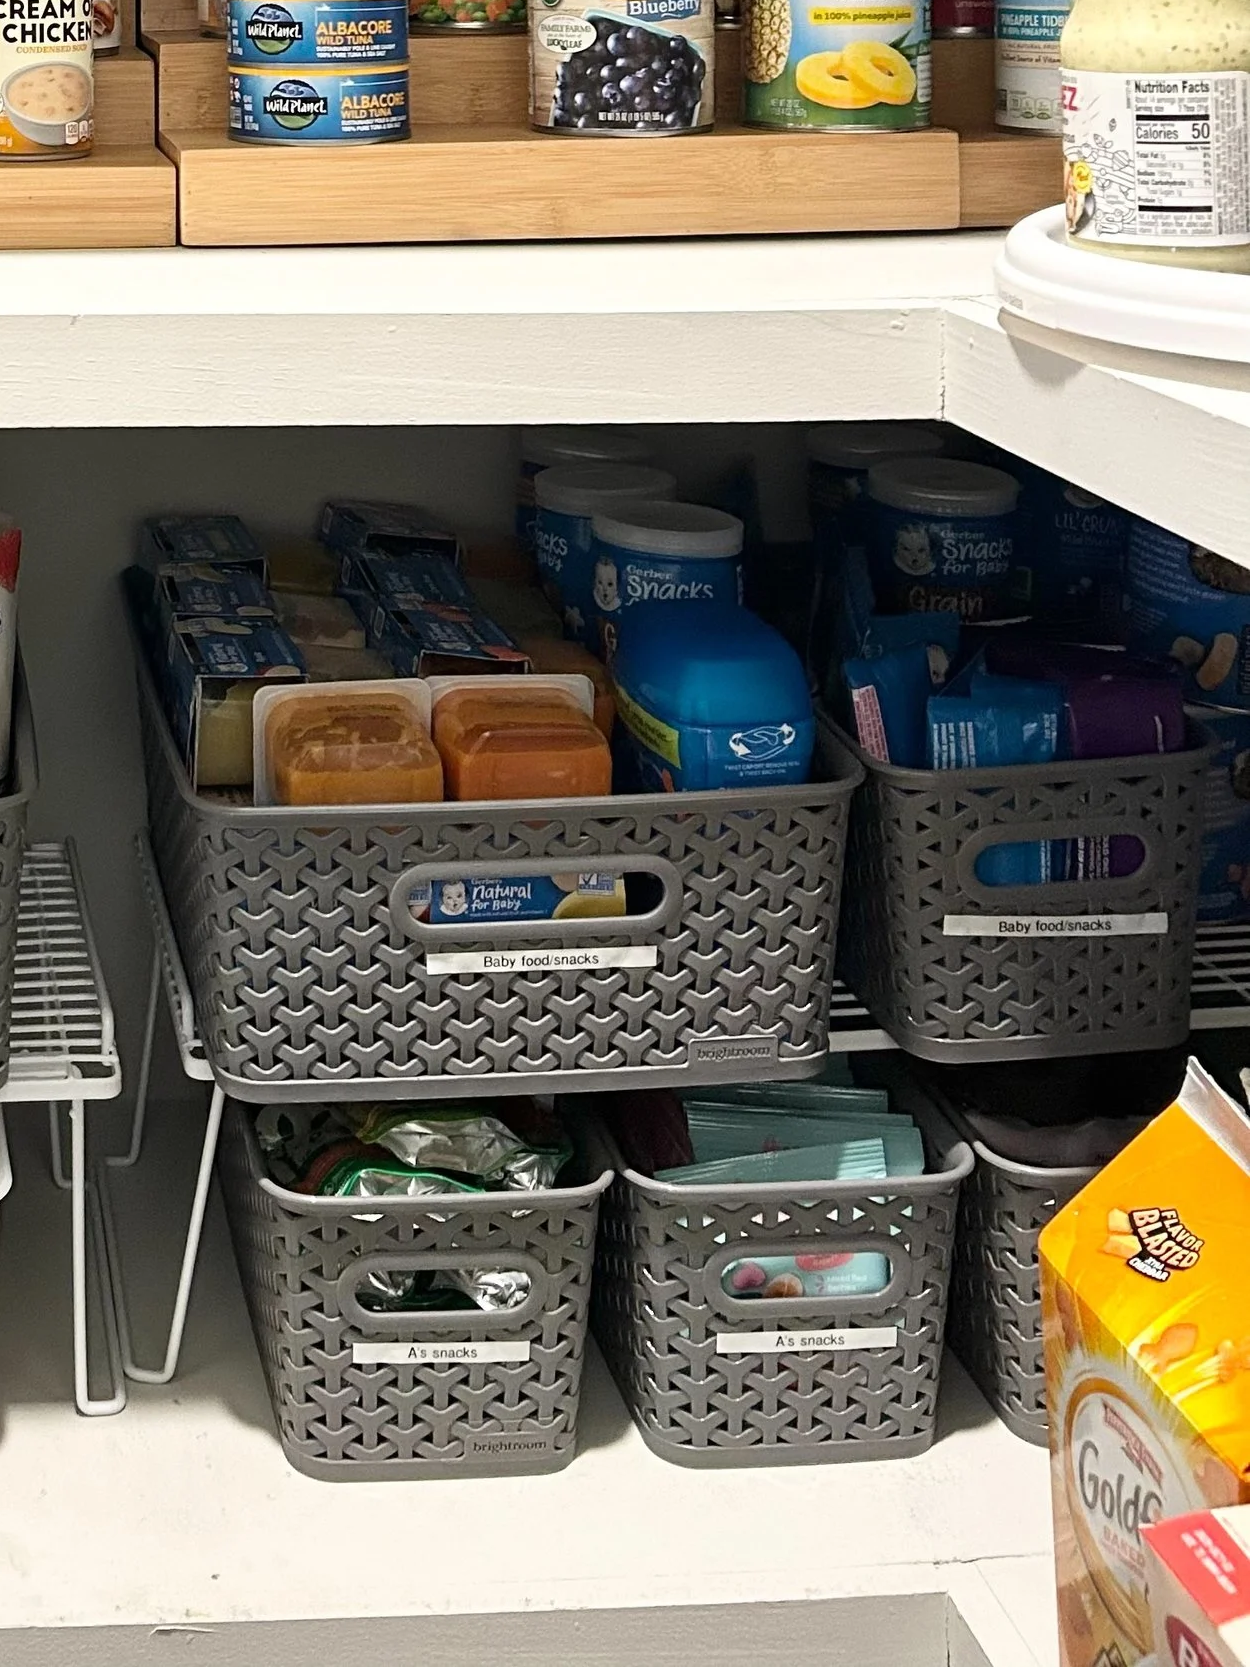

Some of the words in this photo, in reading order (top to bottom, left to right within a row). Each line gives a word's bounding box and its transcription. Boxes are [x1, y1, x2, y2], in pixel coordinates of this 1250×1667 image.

[1134, 81, 1178, 94] Nutrition
[1182, 81, 1210, 93] Facts
[1136, 127, 1178, 139] Calories
[1191, 123, 1210, 138] 50
[627, 575, 714, 601] Snacks
[472, 883, 532, 900] Natural
[999, 920, 1031, 934] Baby
[1035, 919, 1112, 932] food/snacks
[483, 955, 516, 969] Baby
[521, 953, 599, 966] food/snacks
[1161, 1209, 1205, 1250] FLAVOR
[1133, 1210, 1199, 1270] BLASTED
[776, 1335, 795, 1347] A's
[800, 1334, 845, 1346] snacks
[408, 1346, 427, 1359] A's
[432, 1347, 478, 1358] snacks
[473, 1439, 548, 1455] brightroom
